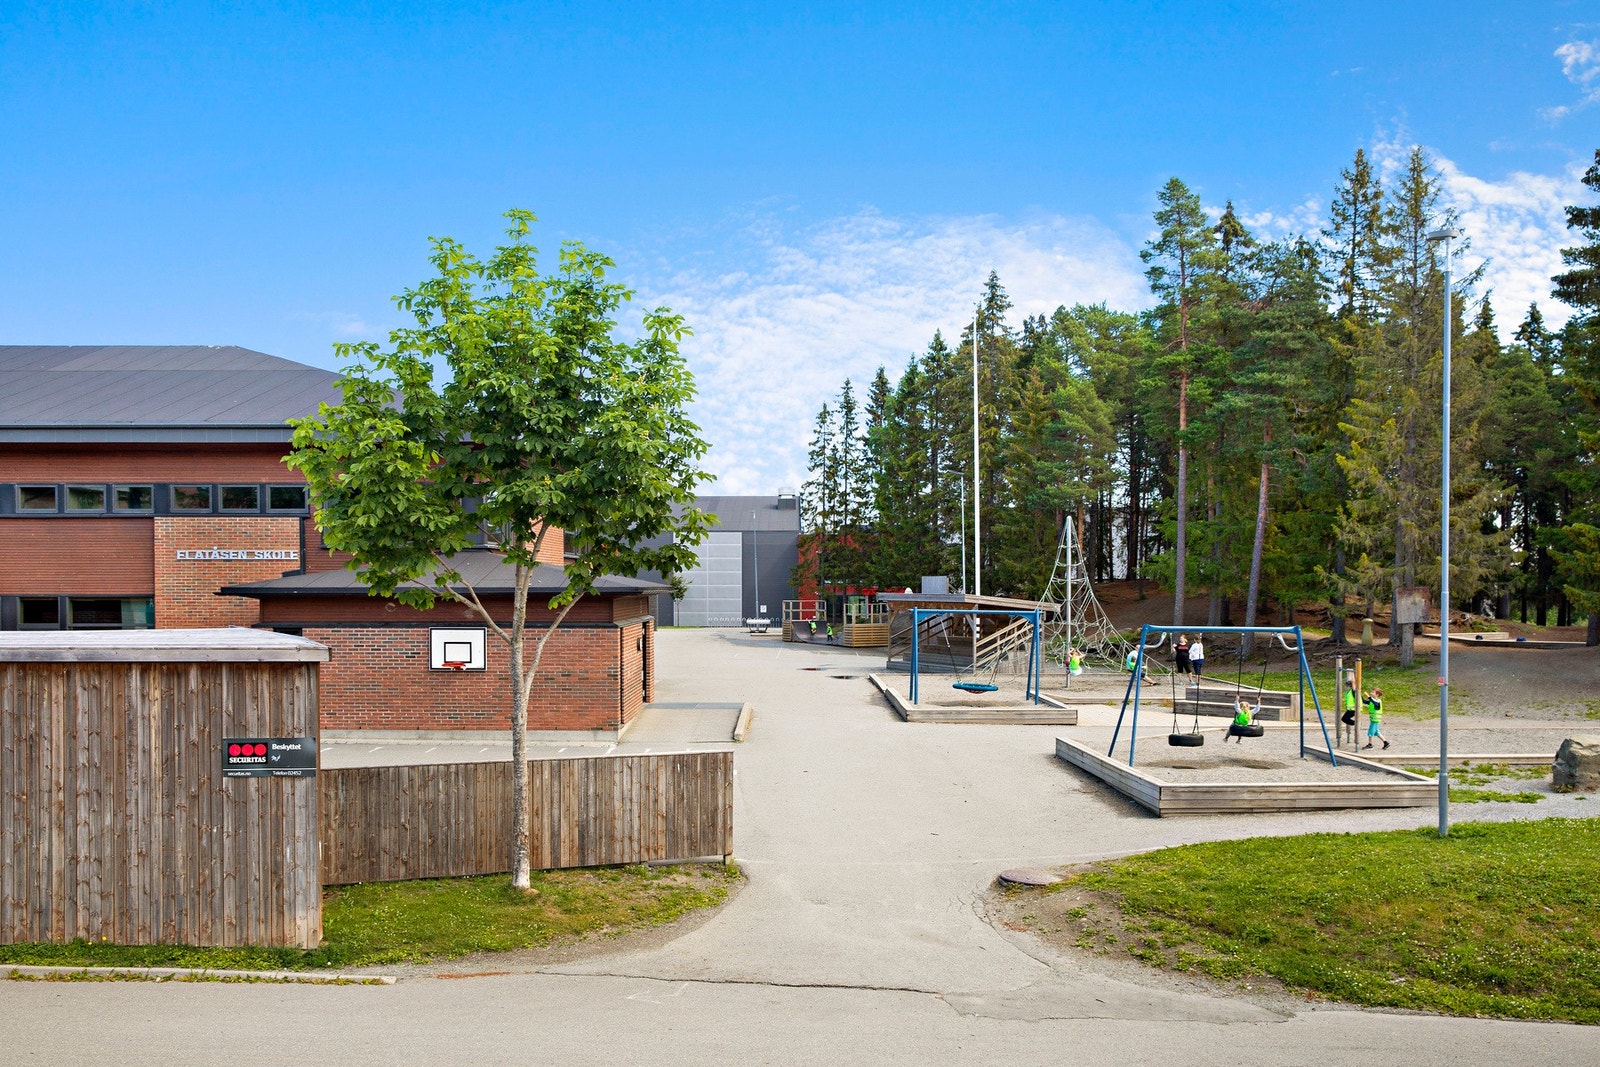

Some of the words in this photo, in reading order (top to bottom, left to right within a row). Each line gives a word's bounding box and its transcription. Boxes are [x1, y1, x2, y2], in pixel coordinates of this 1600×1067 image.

[176, 546, 247, 560] FLATÅSEN
[254, 550, 299, 560] SKOLE
[271, 743, 302, 751] Beskyttet
[228, 756, 267, 764] SECURITAS
